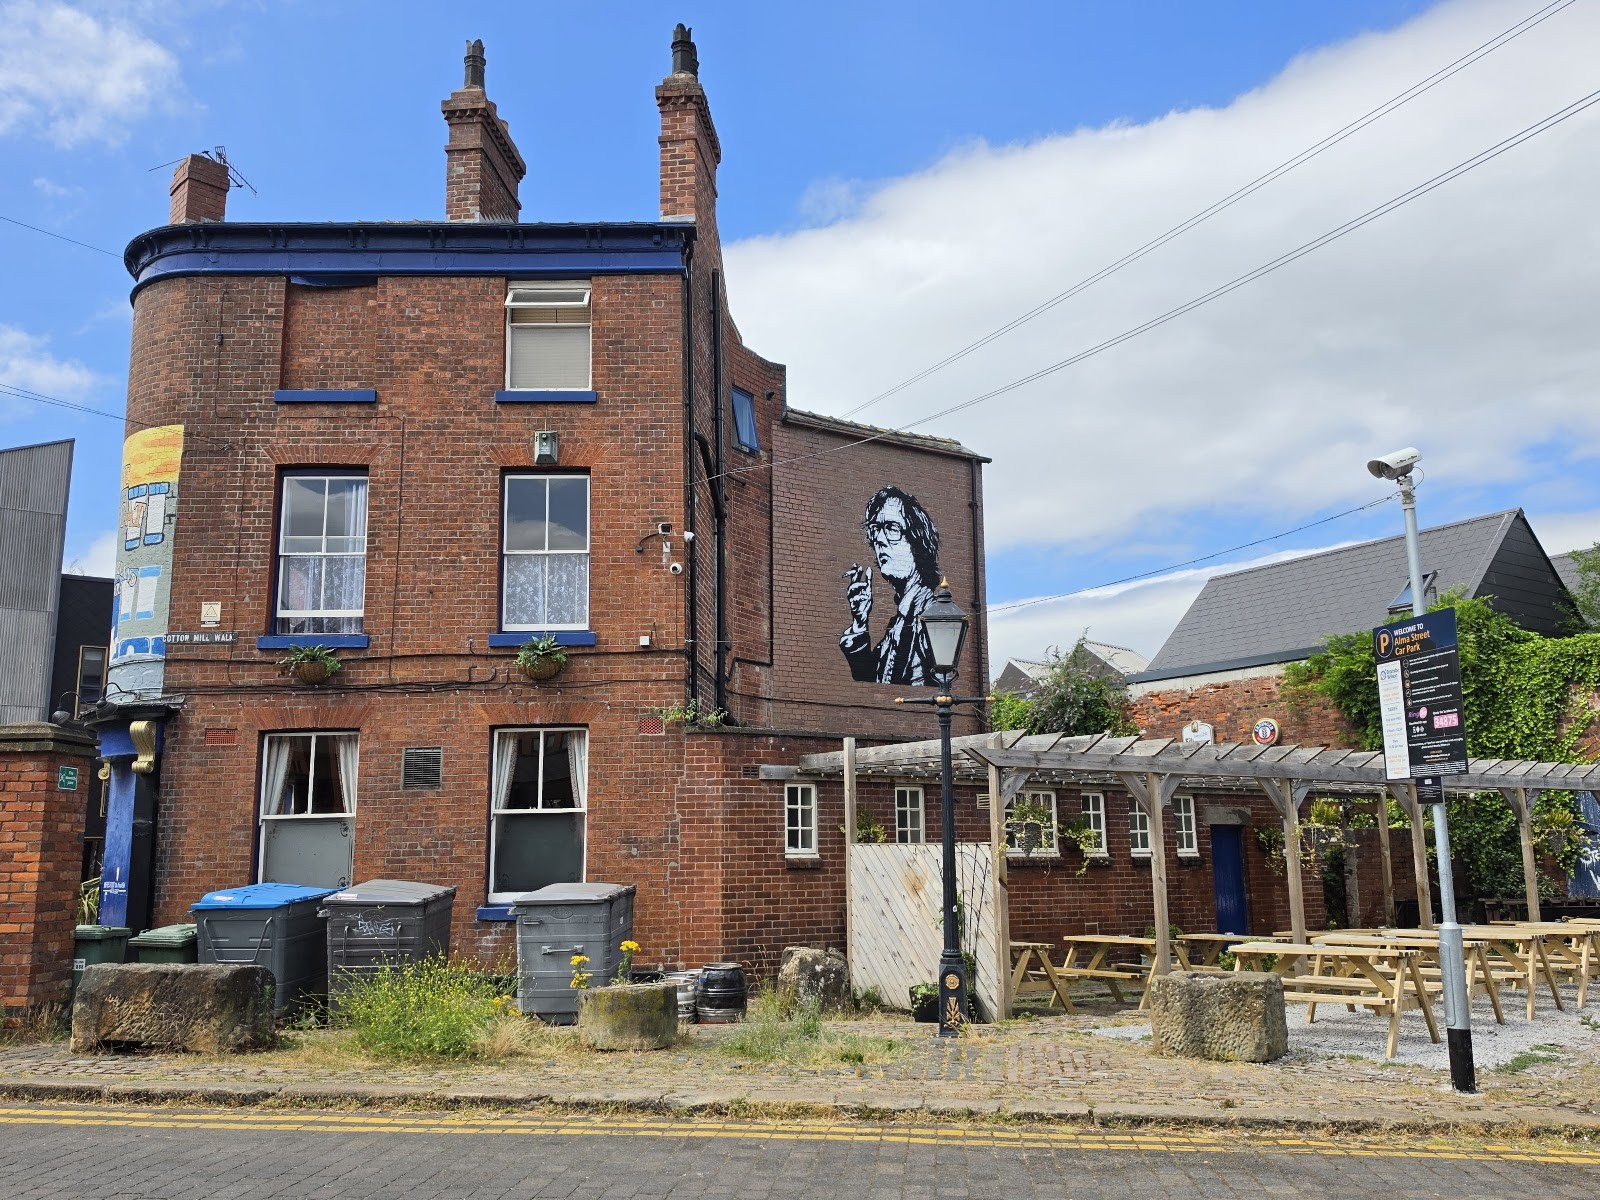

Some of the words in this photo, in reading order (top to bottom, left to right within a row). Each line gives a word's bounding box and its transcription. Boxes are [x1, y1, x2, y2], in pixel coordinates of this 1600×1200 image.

[1394, 625, 1416, 636] WELCOME
[162, 634, 190, 642] COTTON
[1380, 634, 1389, 654] P
[1394, 636, 1410, 646] Alma
[1411, 630, 1430, 642] Street
[1395, 648, 1406, 656] Car
[1406, 642, 1420, 653] Park
[1434, 716, 1458, 728] 34875
